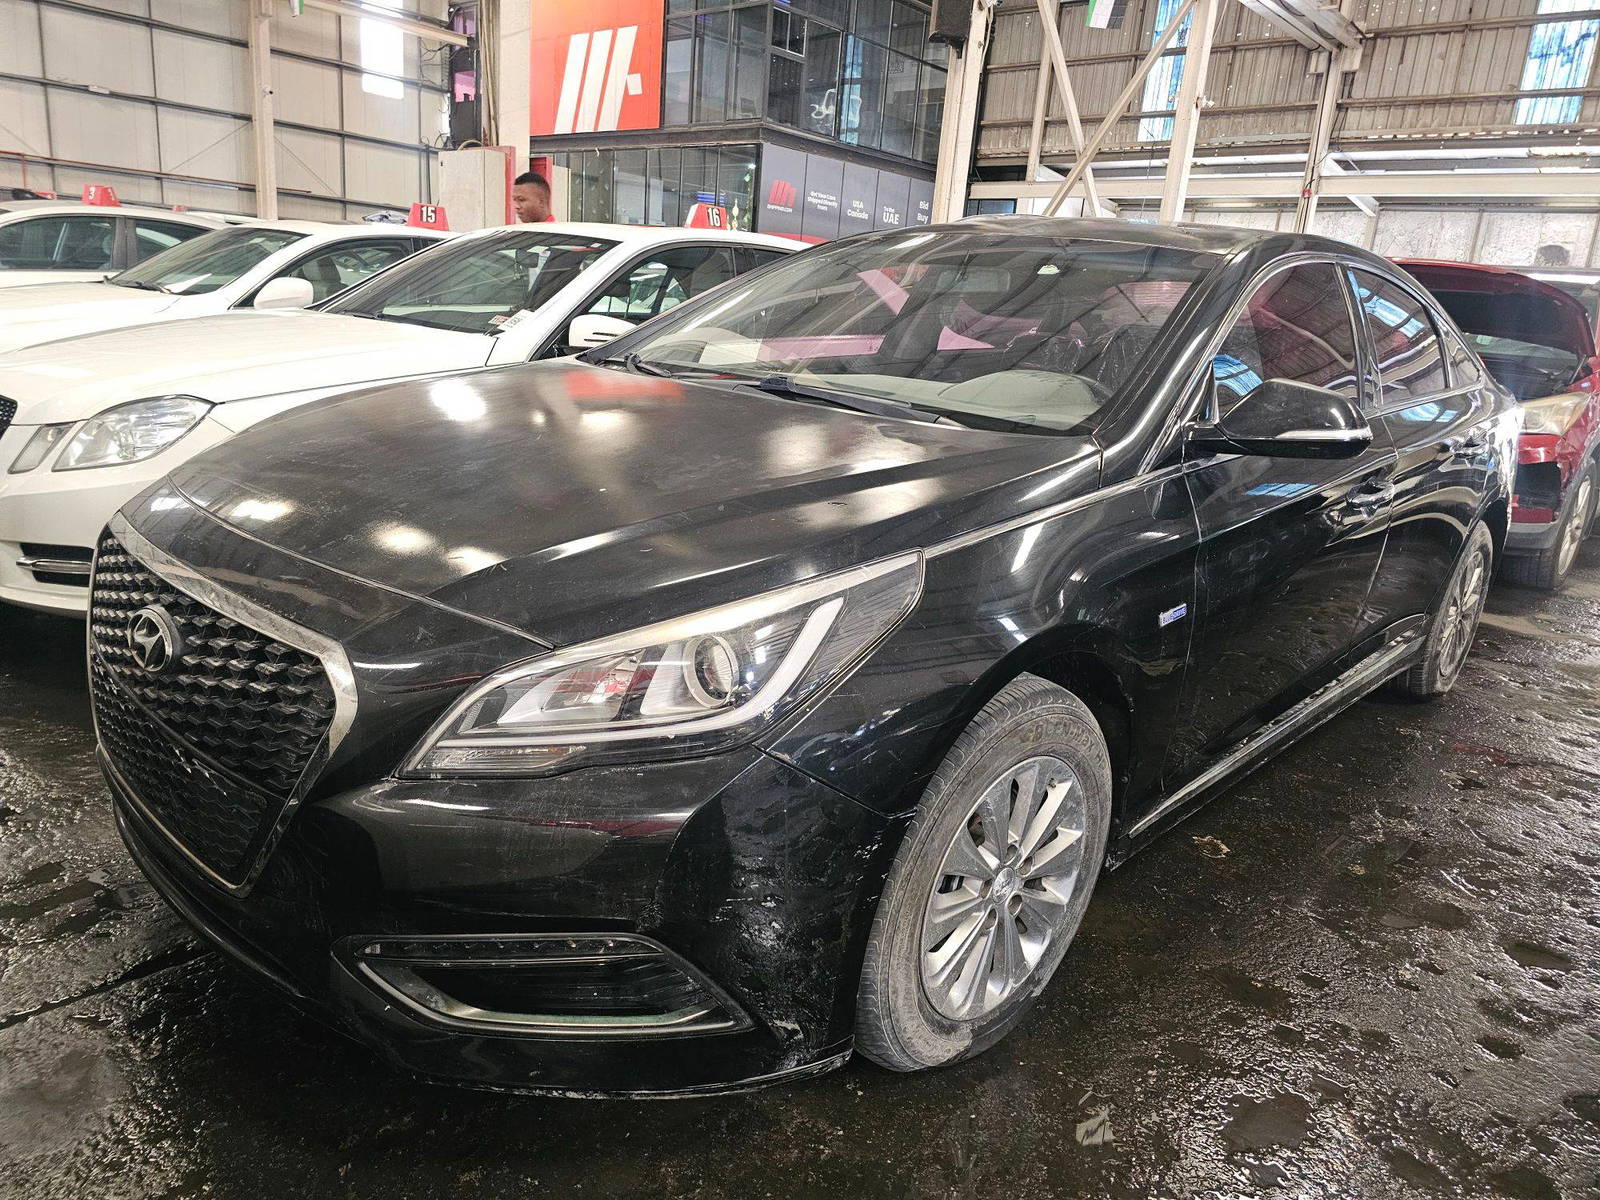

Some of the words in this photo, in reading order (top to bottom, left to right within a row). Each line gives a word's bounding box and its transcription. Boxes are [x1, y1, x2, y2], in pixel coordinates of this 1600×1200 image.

[852, 200, 864, 208] USA
[920, 200, 929, 210] Bid
[421, 206, 436, 223] 15
[707, 207, 721, 227] 16
[847, 209, 868, 219] Canada
[883, 212, 899, 224] UAE
[917, 213, 928, 224] Buy
